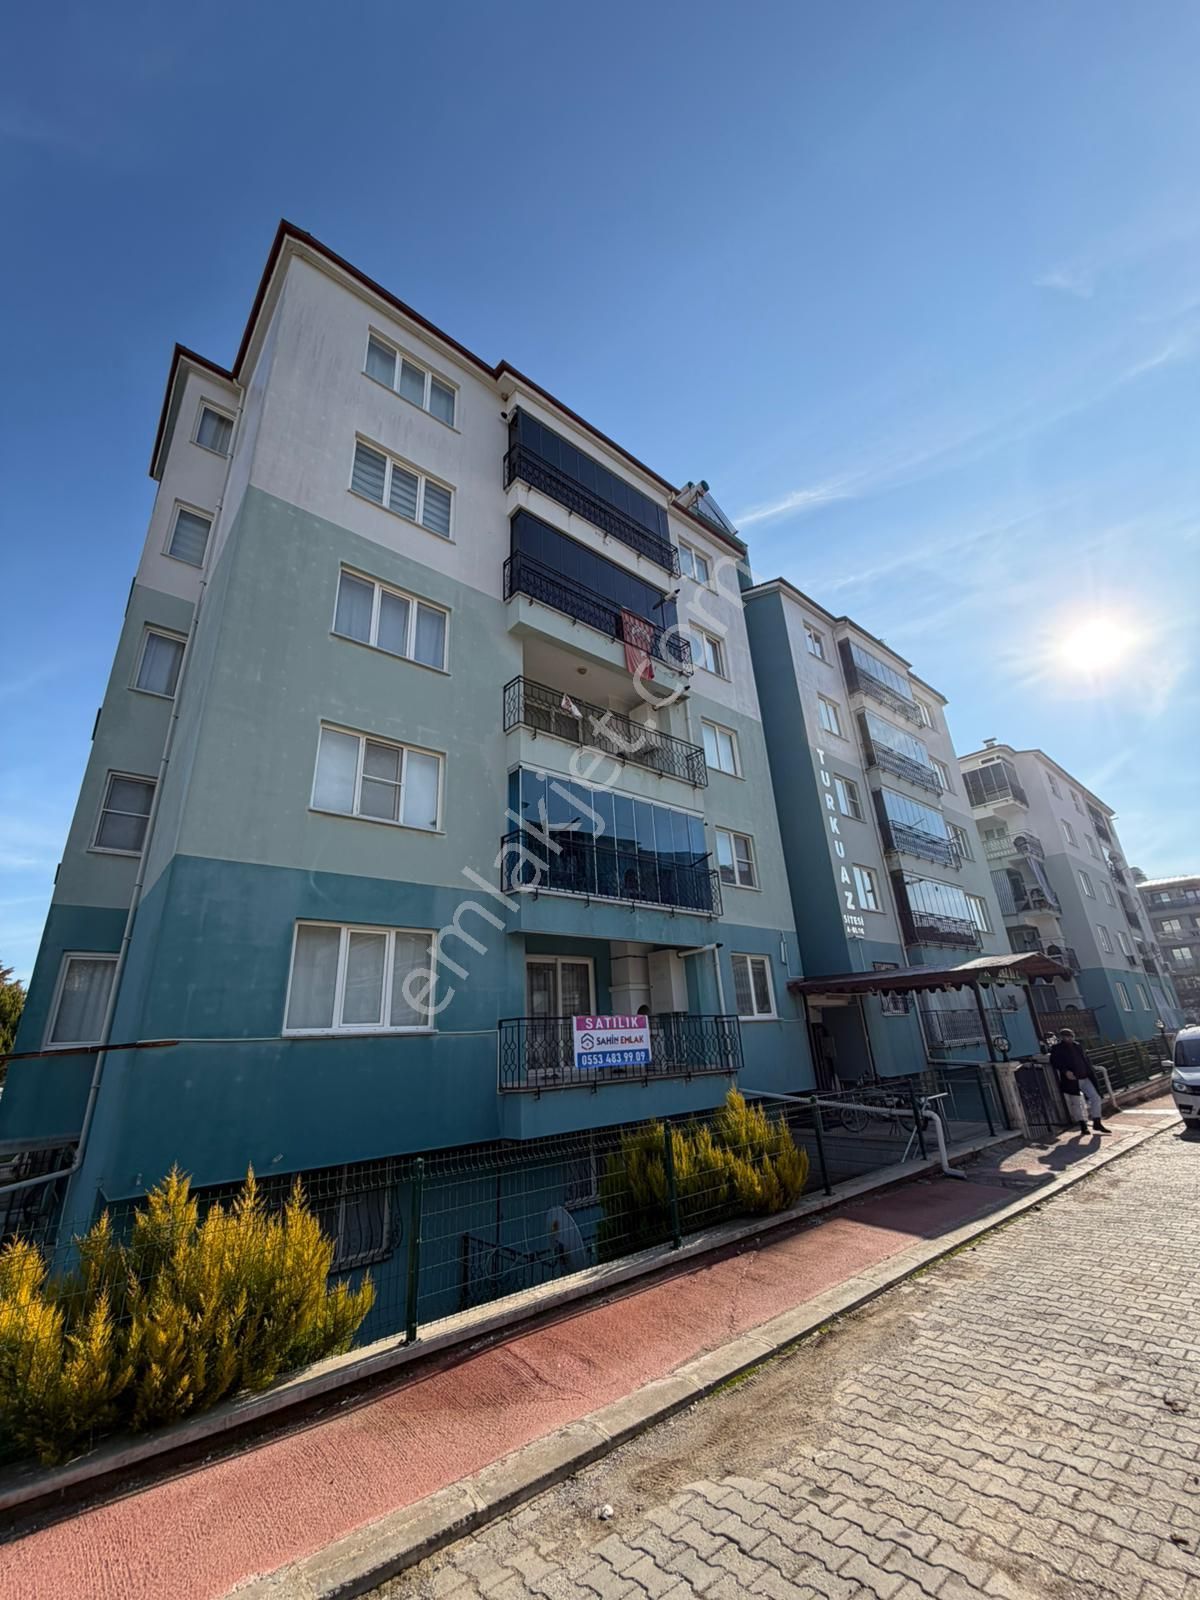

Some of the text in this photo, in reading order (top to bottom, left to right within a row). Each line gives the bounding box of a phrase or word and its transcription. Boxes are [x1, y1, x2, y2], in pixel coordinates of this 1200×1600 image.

[816, 748, 855, 910] TURKUAZ
[585, 1017, 639, 1029] SATILIK
[620, 1035, 644, 1045] EMLAK
[581, 1055, 603, 1066] 0553
[605, 1053, 622, 1064] 483
[623, 1052, 633, 1062] 99
